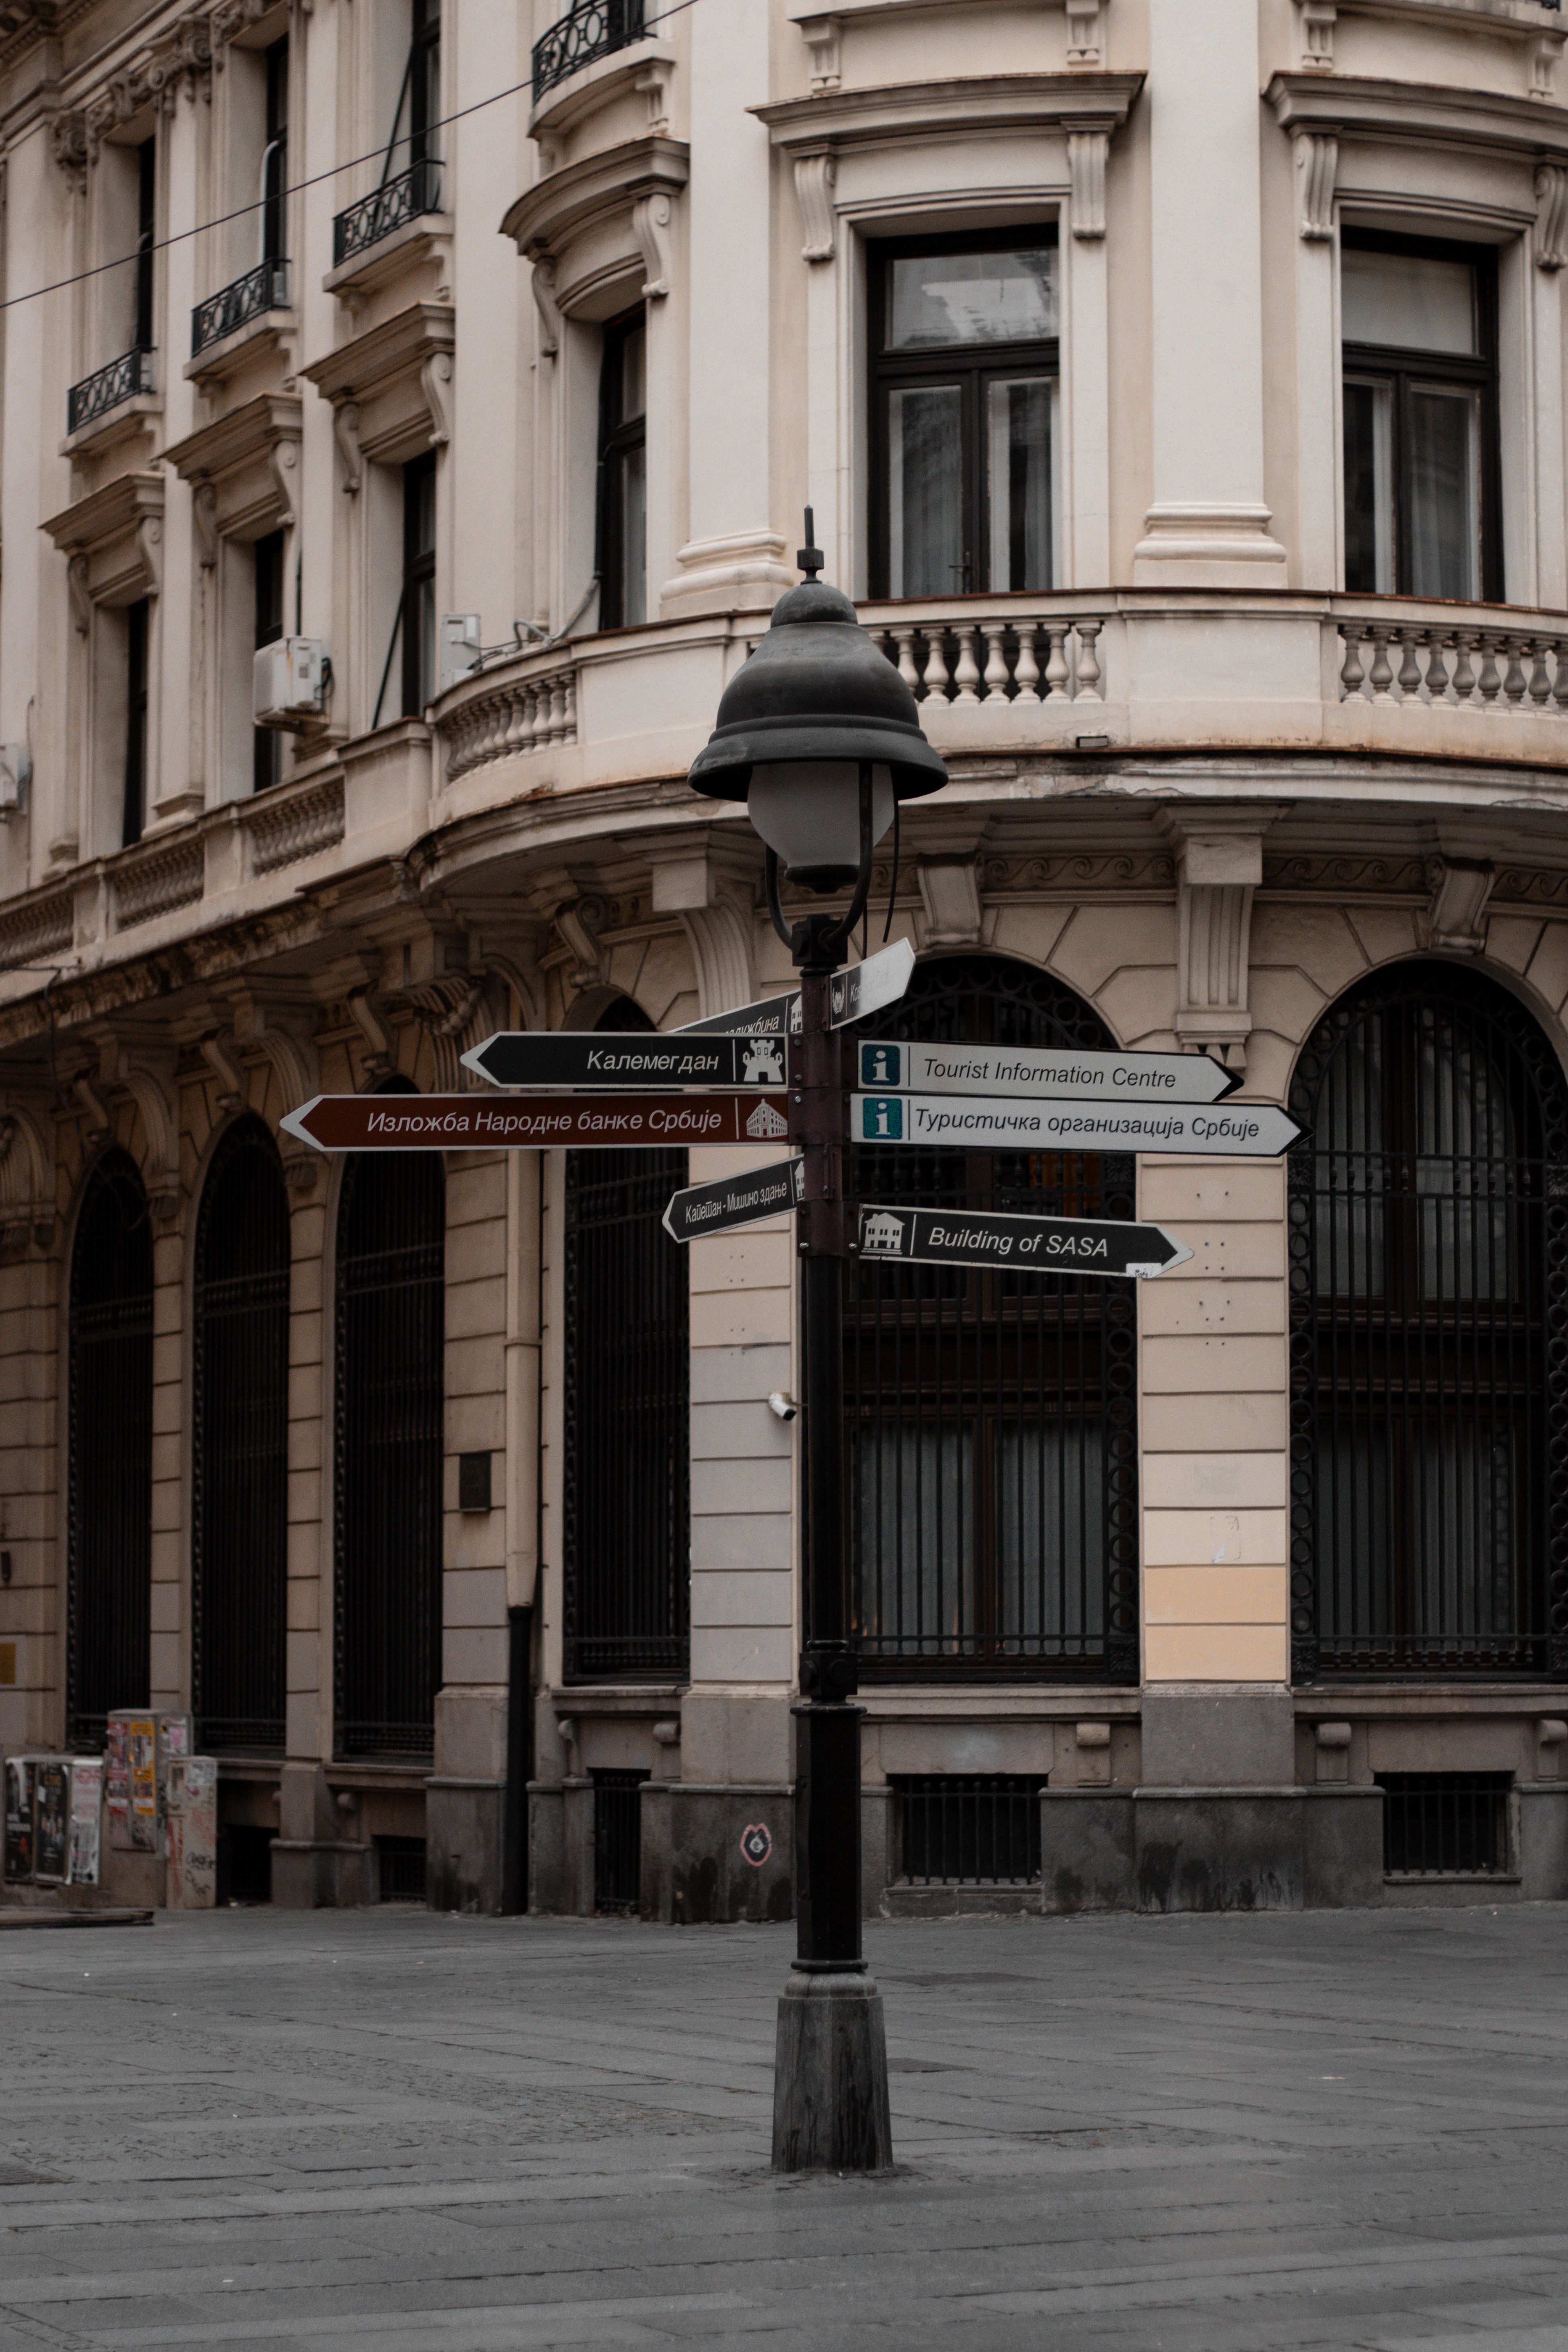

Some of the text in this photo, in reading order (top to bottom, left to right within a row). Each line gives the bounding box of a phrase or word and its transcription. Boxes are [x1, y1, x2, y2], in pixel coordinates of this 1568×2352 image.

[587, 1051, 719, 1074] Калемегдан
[925, 1059, 1175, 1088] Tourist Information Centre
[367, 1110, 721, 1135] Изложба Народне банке Србије
[916, 1108, 1259, 1141] Туристичка организација Србије
[727, 1189, 758, 1212] Мишино
[760, 1182, 787, 1206] здање
[928, 1227, 1107, 1257] Building of SASA
